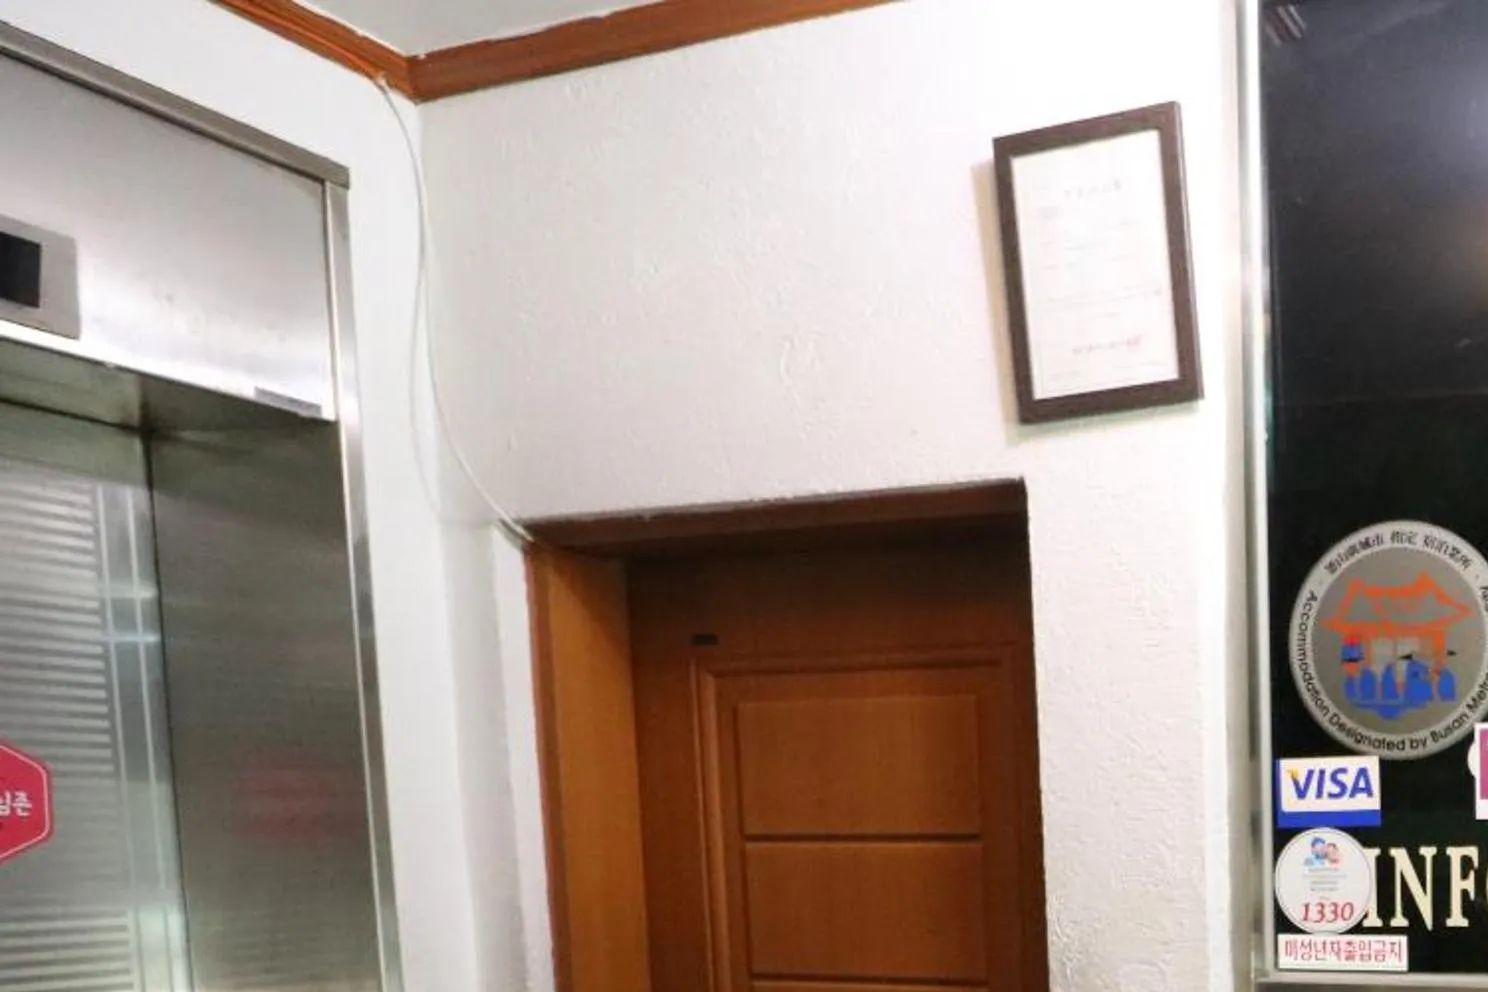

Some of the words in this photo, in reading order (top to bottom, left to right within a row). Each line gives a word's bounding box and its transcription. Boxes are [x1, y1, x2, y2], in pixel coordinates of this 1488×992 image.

[1297, 591, 1331, 717] Accommodation
[1329, 713, 1406, 751] Designated
[1409, 737, 1428, 751] by
[1430, 713, 1470, 744] Busan
[1289, 767, 1375, 800] VISA
[1301, 902, 1355, 924] 1330
[1284, 939, 1403, 963] 미성년자출입금지
